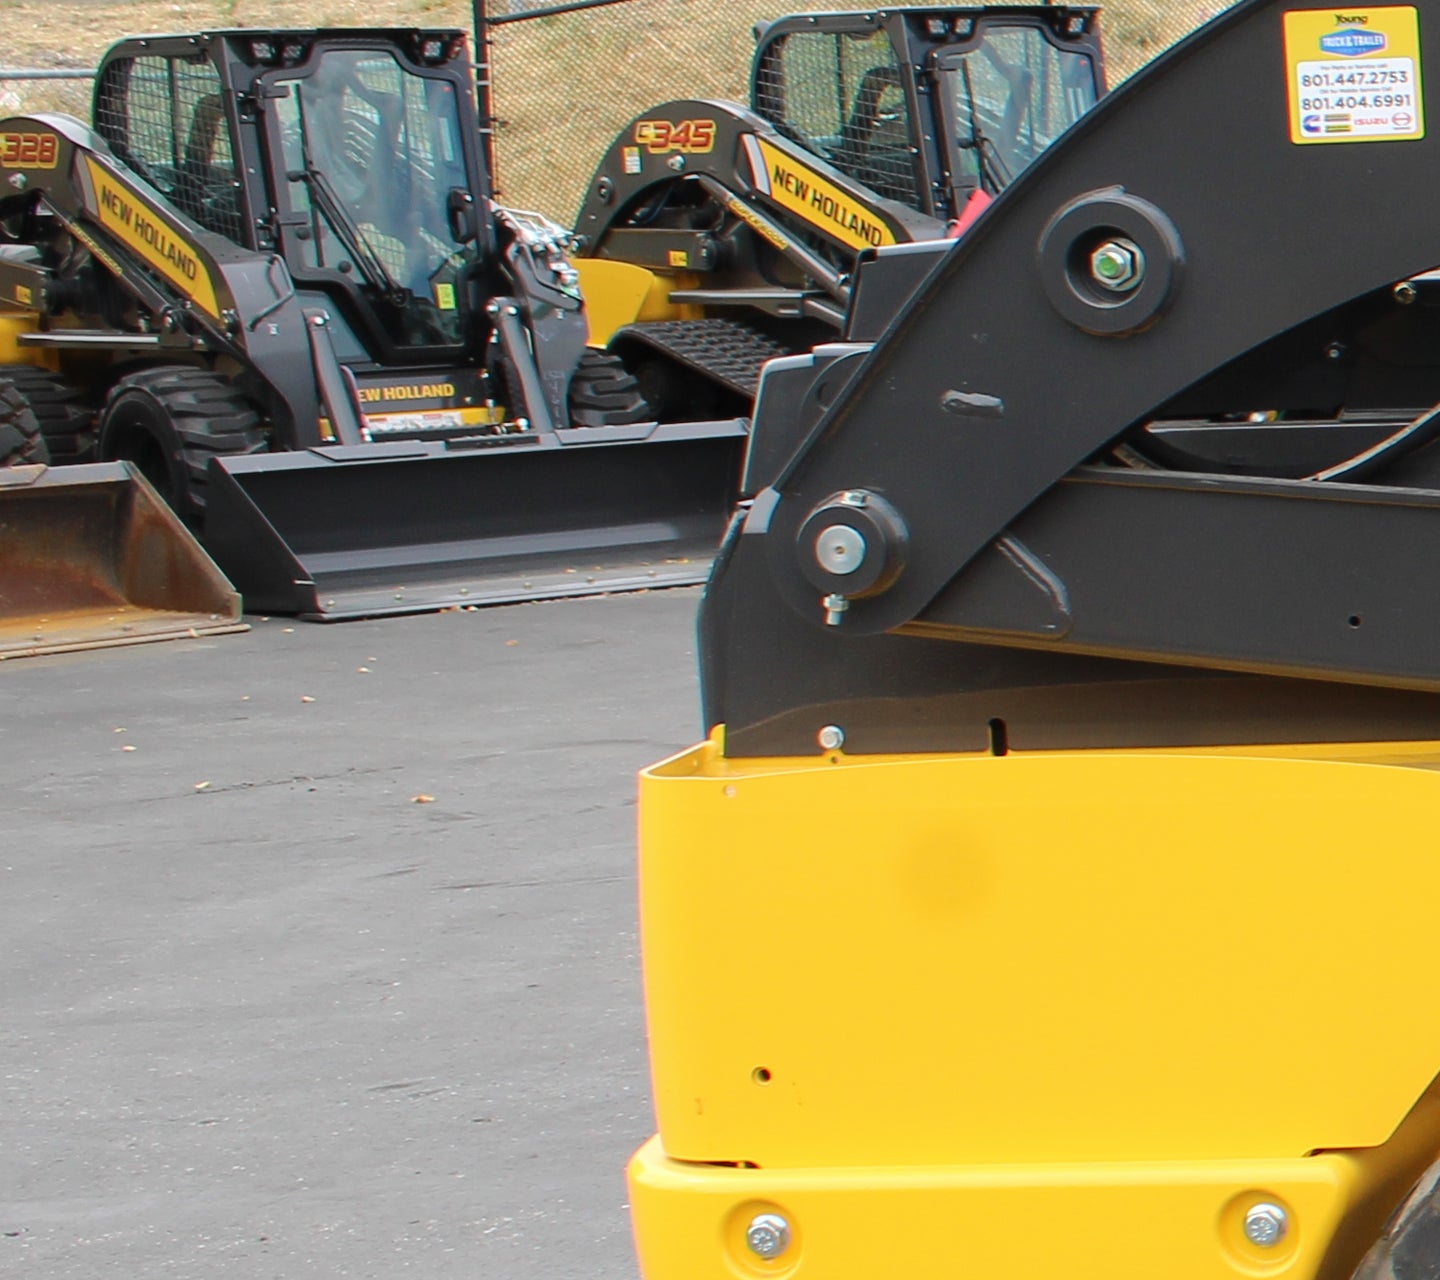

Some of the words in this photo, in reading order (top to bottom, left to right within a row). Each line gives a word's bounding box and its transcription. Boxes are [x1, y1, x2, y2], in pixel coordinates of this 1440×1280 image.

[1335, 14, 1369, 26] Young
[1301, 71, 1408, 88] 801.447.2753
[1301, 94, 1411, 110] 801.404.6991
[0, 134, 58, 168] 328
[773, 166, 807, 200] NEW
[811, 189, 882, 247] HOLLAND
[101, 184, 133, 227] NEW
[134, 214, 197, 281] HOLLAND
[359, 388, 381, 402] EW
[383, 383, 455, 401] HOLLAND
